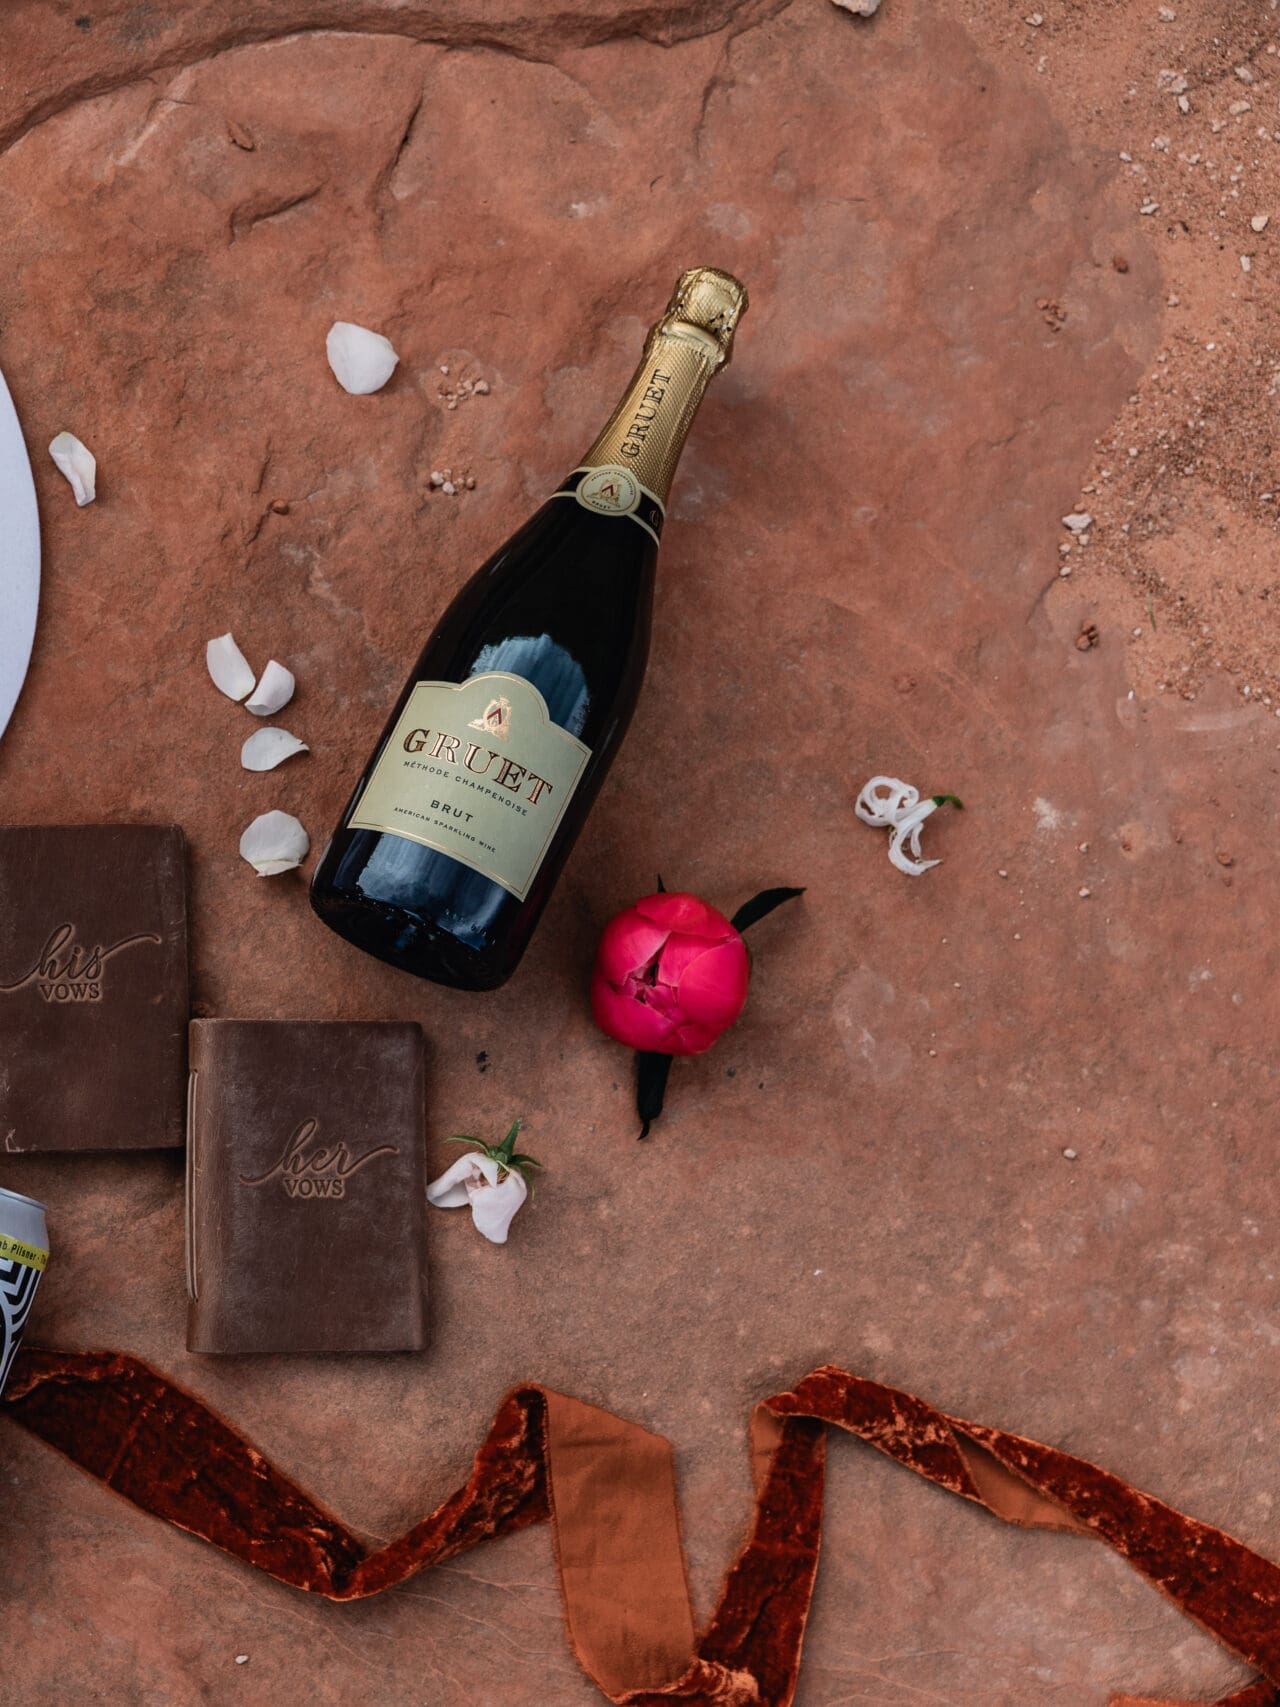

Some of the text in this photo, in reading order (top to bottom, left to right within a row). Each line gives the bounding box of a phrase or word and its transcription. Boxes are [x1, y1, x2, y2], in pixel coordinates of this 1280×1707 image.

[620, 369, 671, 459] GRUET
[403, 728, 554, 806] GRUET
[403, 759, 529, 817] MÉTHODE CHAMPENOISE
[393, 806, 497, 854] AMERICAN SPARKLING WINE
[430, 800, 474, 823] BRUT
[39, 981, 101, 1001] VOWS
[239, 1117, 401, 1185] her
[284, 1178, 345, 1198] VOWS
[10, 1243, 37, 1261] Pilsner
